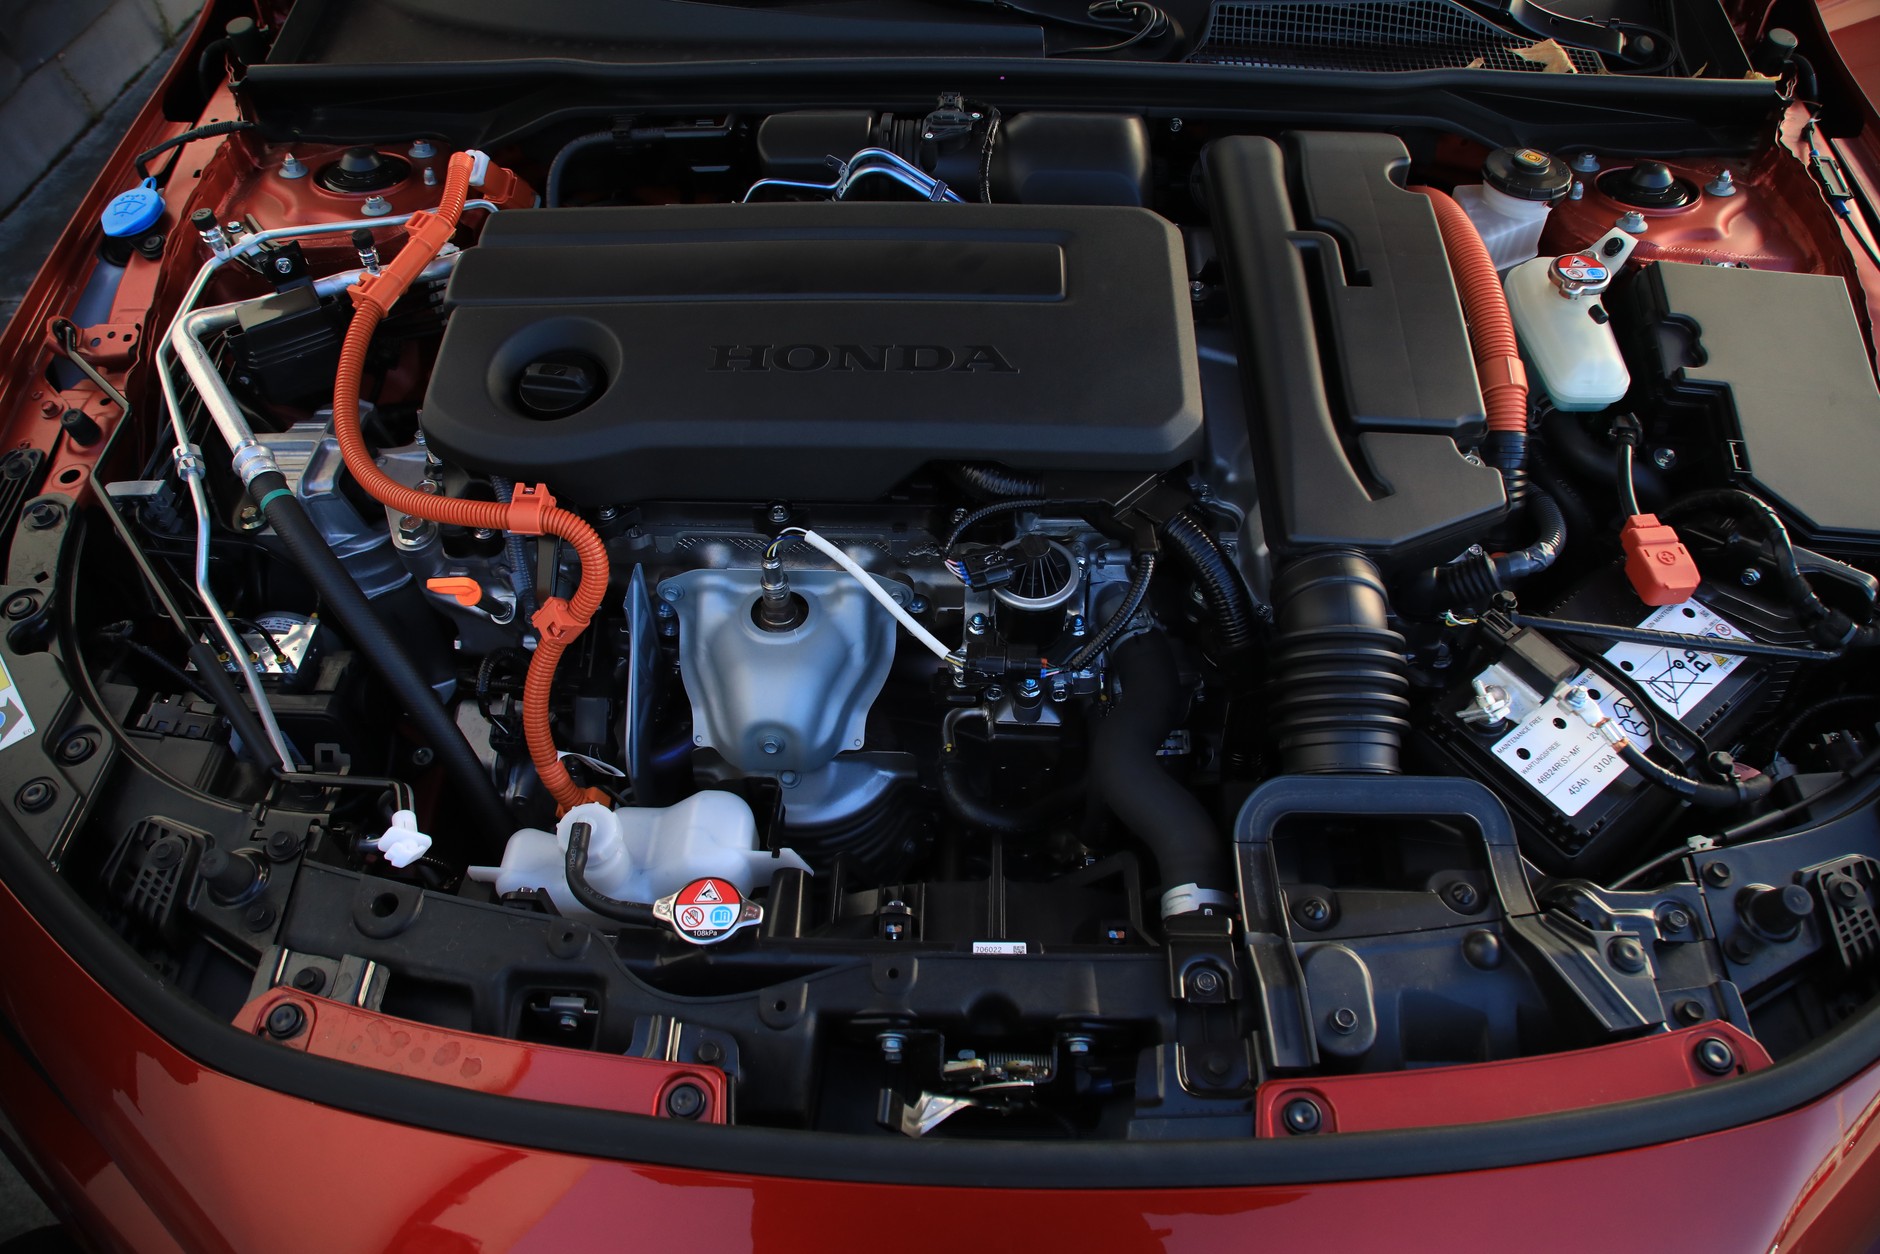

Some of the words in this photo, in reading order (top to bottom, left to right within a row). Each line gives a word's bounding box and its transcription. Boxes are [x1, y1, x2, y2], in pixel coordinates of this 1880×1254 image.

[705, 343, 1020, 373] HONDA
[1683, 649, 1712, 673] Pb
[1496, 725, 1531, 754] MAINTENANCE
[1528, 715, 1543, 728] FREE
[1520, 740, 1561, 775] WARTUNGSFREIE
[1537, 744, 1581, 785] 46B24R(S)-MF
[1586, 728, 1601, 742] 12V
[1568, 777, 1591, 796] 45Ah
[1593, 754, 1616, 773] 310A
[693, 929, 718, 937] 108kPa
